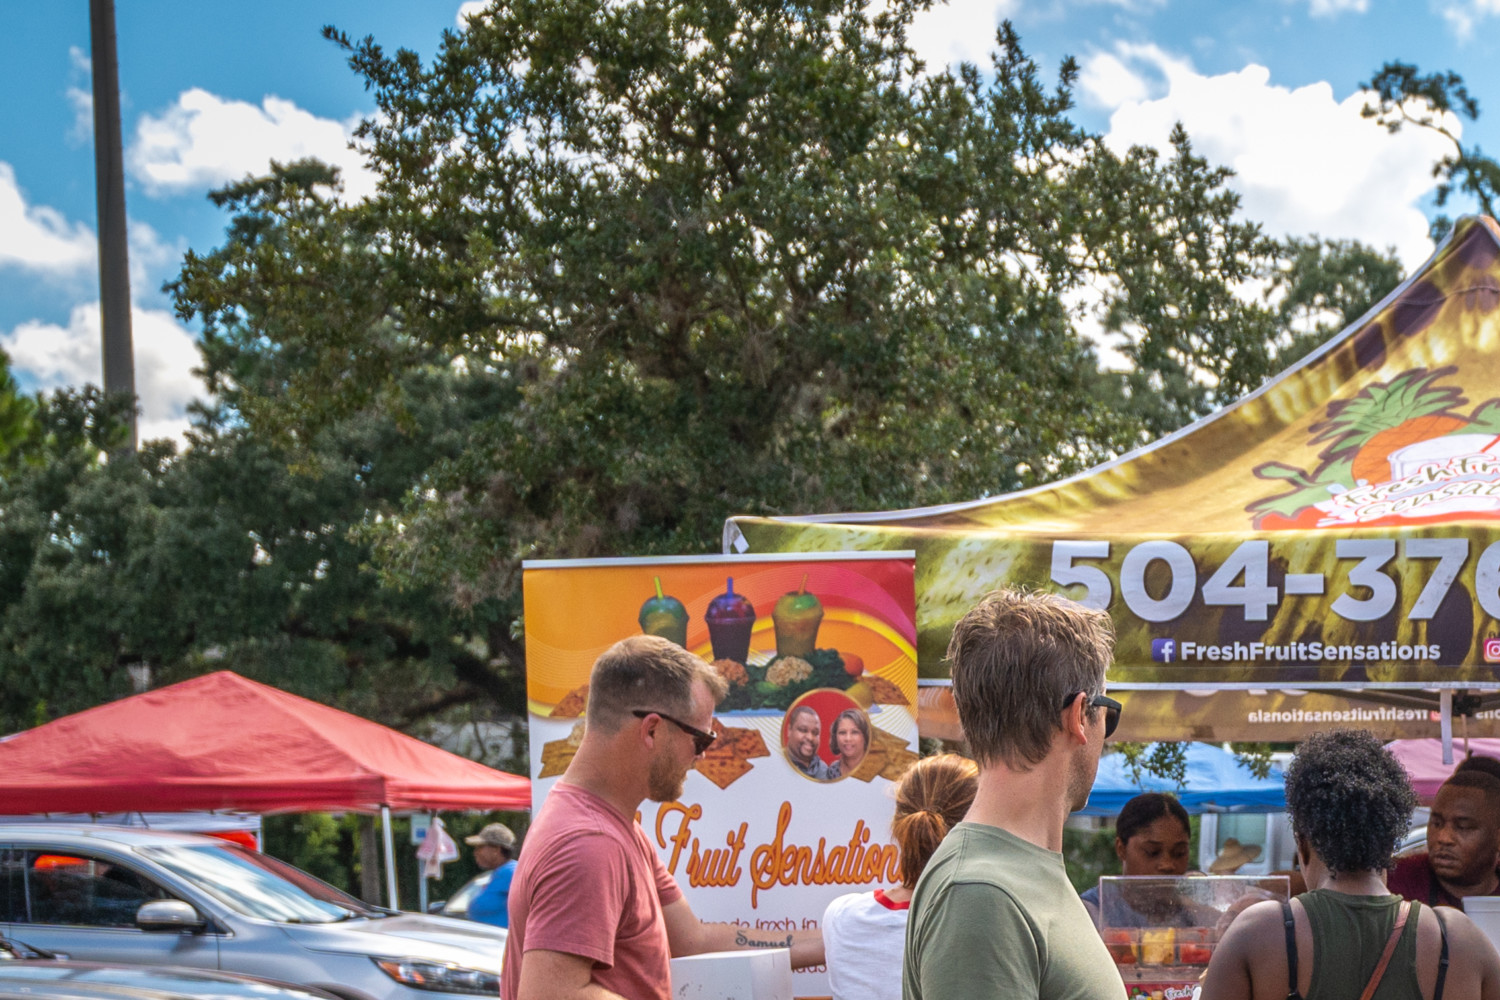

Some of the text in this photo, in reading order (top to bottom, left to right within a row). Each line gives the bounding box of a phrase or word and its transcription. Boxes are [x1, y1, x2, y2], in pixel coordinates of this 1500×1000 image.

[1181, 641, 1441, 662] FreshFruitSensations
[655, 800, 904, 910] Fruit Sensation
[735, 930, 794, 949] Samuel
